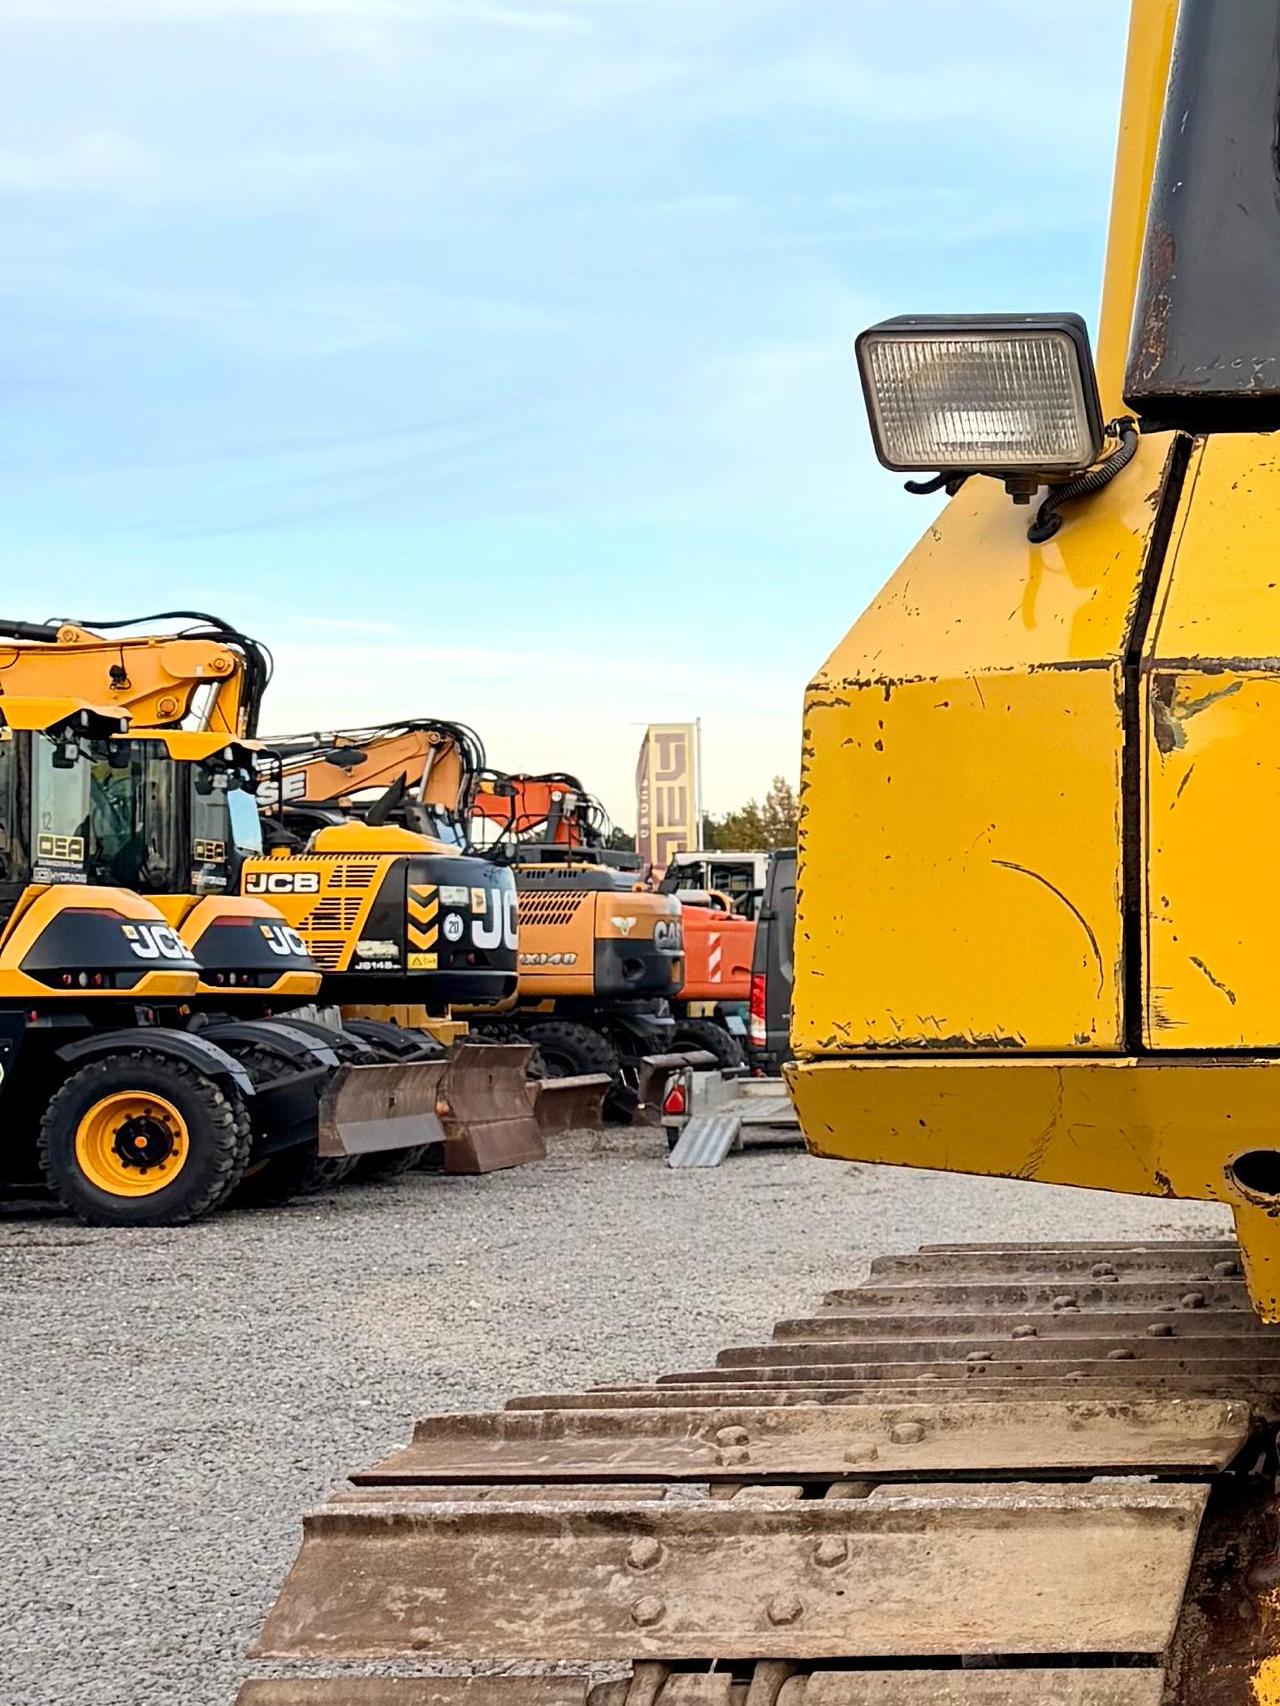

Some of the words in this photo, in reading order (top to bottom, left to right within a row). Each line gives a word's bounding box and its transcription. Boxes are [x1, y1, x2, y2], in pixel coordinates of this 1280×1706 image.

[246, 873, 318, 892] JCB
[473, 888, 518, 949] JC
[267, 925, 309, 956] JC
[655, 920, 681, 949] CA
